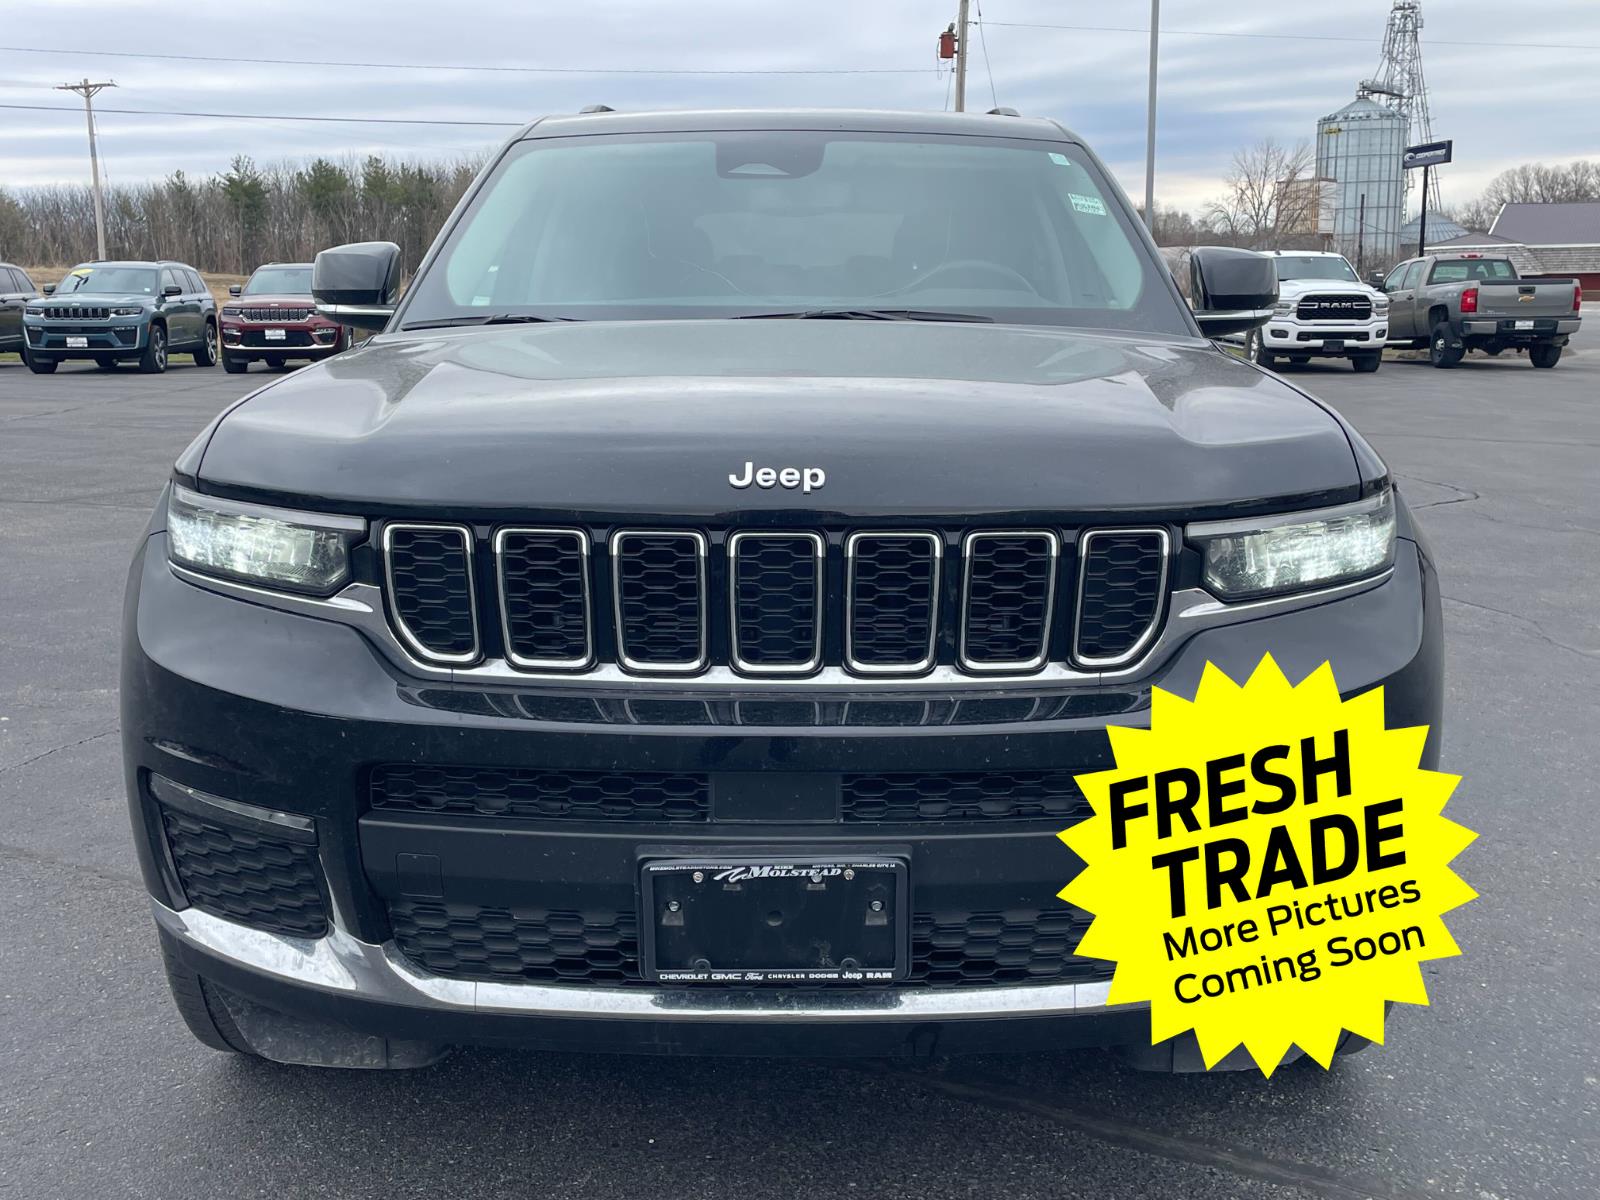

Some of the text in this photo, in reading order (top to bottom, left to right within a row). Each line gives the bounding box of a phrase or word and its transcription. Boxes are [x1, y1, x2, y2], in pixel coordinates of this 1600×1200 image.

[728, 461, 826, 494] Jeep
[747, 866, 842, 878] MOLSTEAD
[744, 972, 764, 980] Ford
[842, 971, 863, 980] Jeep
